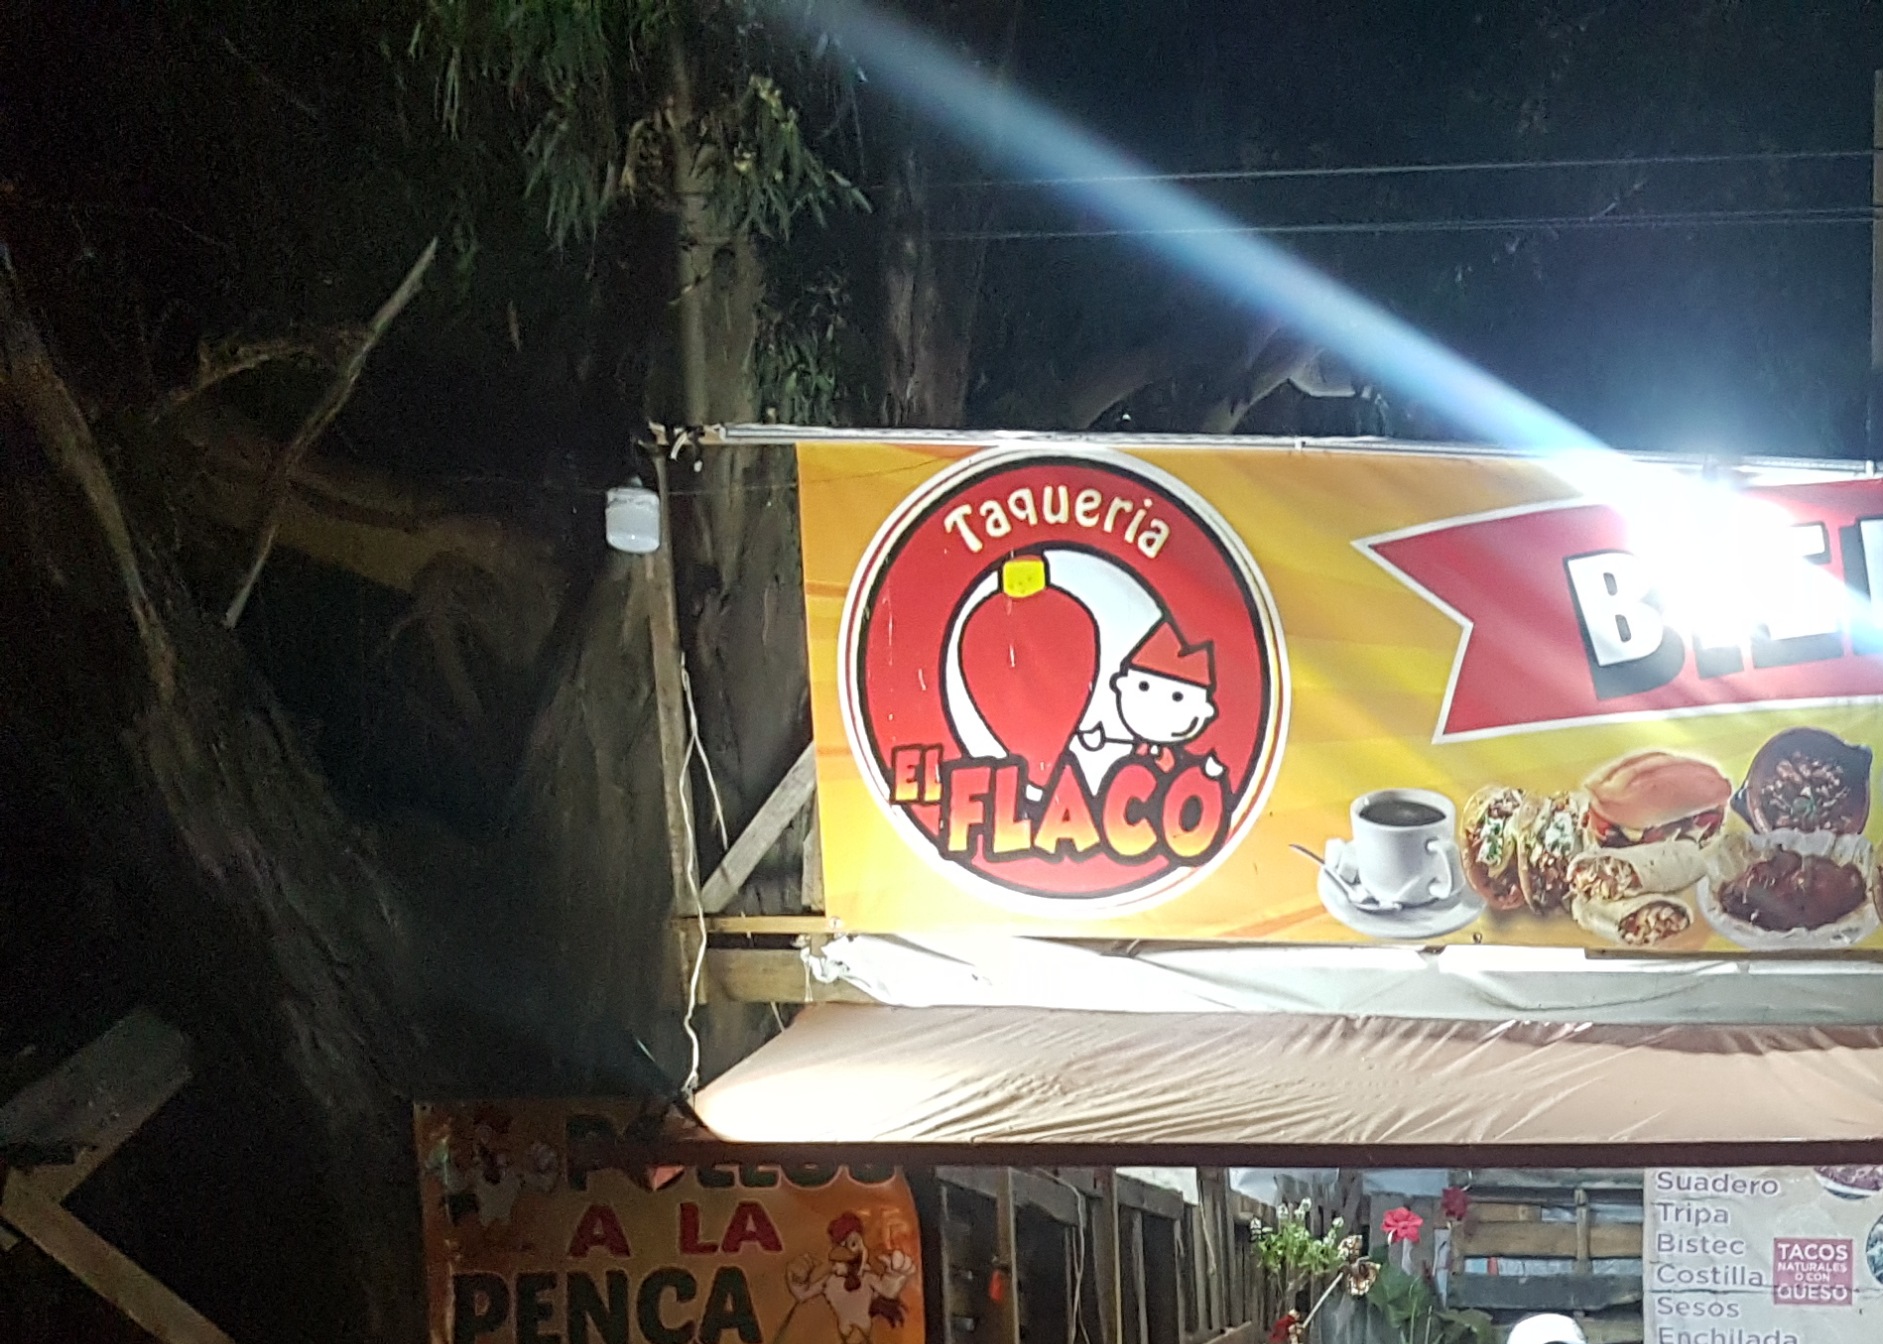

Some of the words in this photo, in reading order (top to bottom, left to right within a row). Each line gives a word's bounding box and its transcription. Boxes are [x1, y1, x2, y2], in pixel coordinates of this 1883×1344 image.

[944, 485, 1171, 559] Taqueria
[892, 746, 943, 803] EL
[945, 758, 1227, 860] FLACO
[1657, 1171, 1779, 1196] Suadero
[1656, 1203, 1729, 1227] Tripa
[568, 1203, 631, 1259] A
[678, 1200, 785, 1255] LA
[1657, 1233, 1745, 1255] Bistec
[1777, 1243, 1848, 1261] TACOS
[1657, 1264, 1763, 1287] Costilla
[1777, 1261, 1848, 1273] NATURALES
[1795, 1272, 1804, 1282] O
[1805, 1272, 1831, 1283] CON
[1777, 1283, 1848, 1301] QUESO
[1657, 1297, 1740, 1318] Sesos
